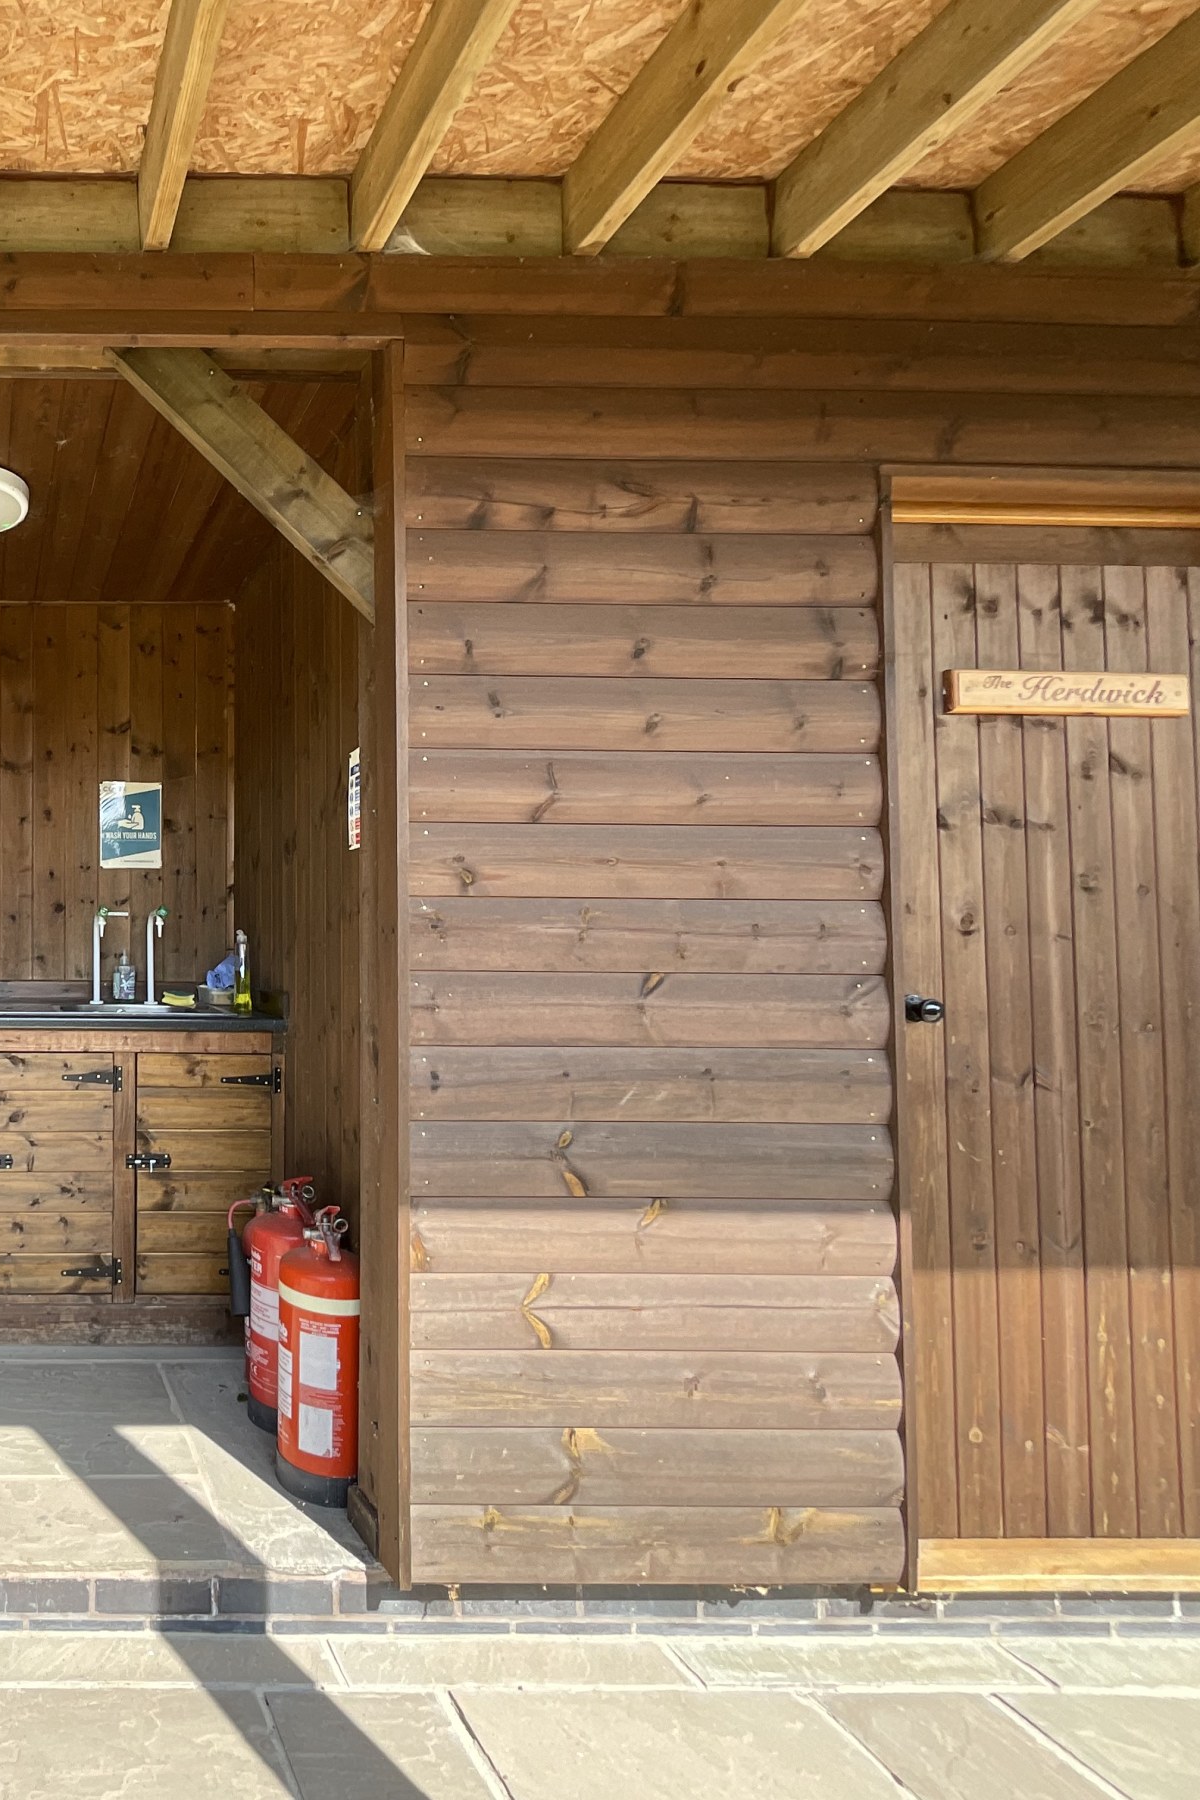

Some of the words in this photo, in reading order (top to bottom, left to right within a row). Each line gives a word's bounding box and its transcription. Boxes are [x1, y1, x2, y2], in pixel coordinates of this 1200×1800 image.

[982, 675, 1014, 690] The
[1017, 675, 1166, 704] Herdwick
[122, 831, 137, 840] YOUR
[137, 831, 157, 840] HANDS
